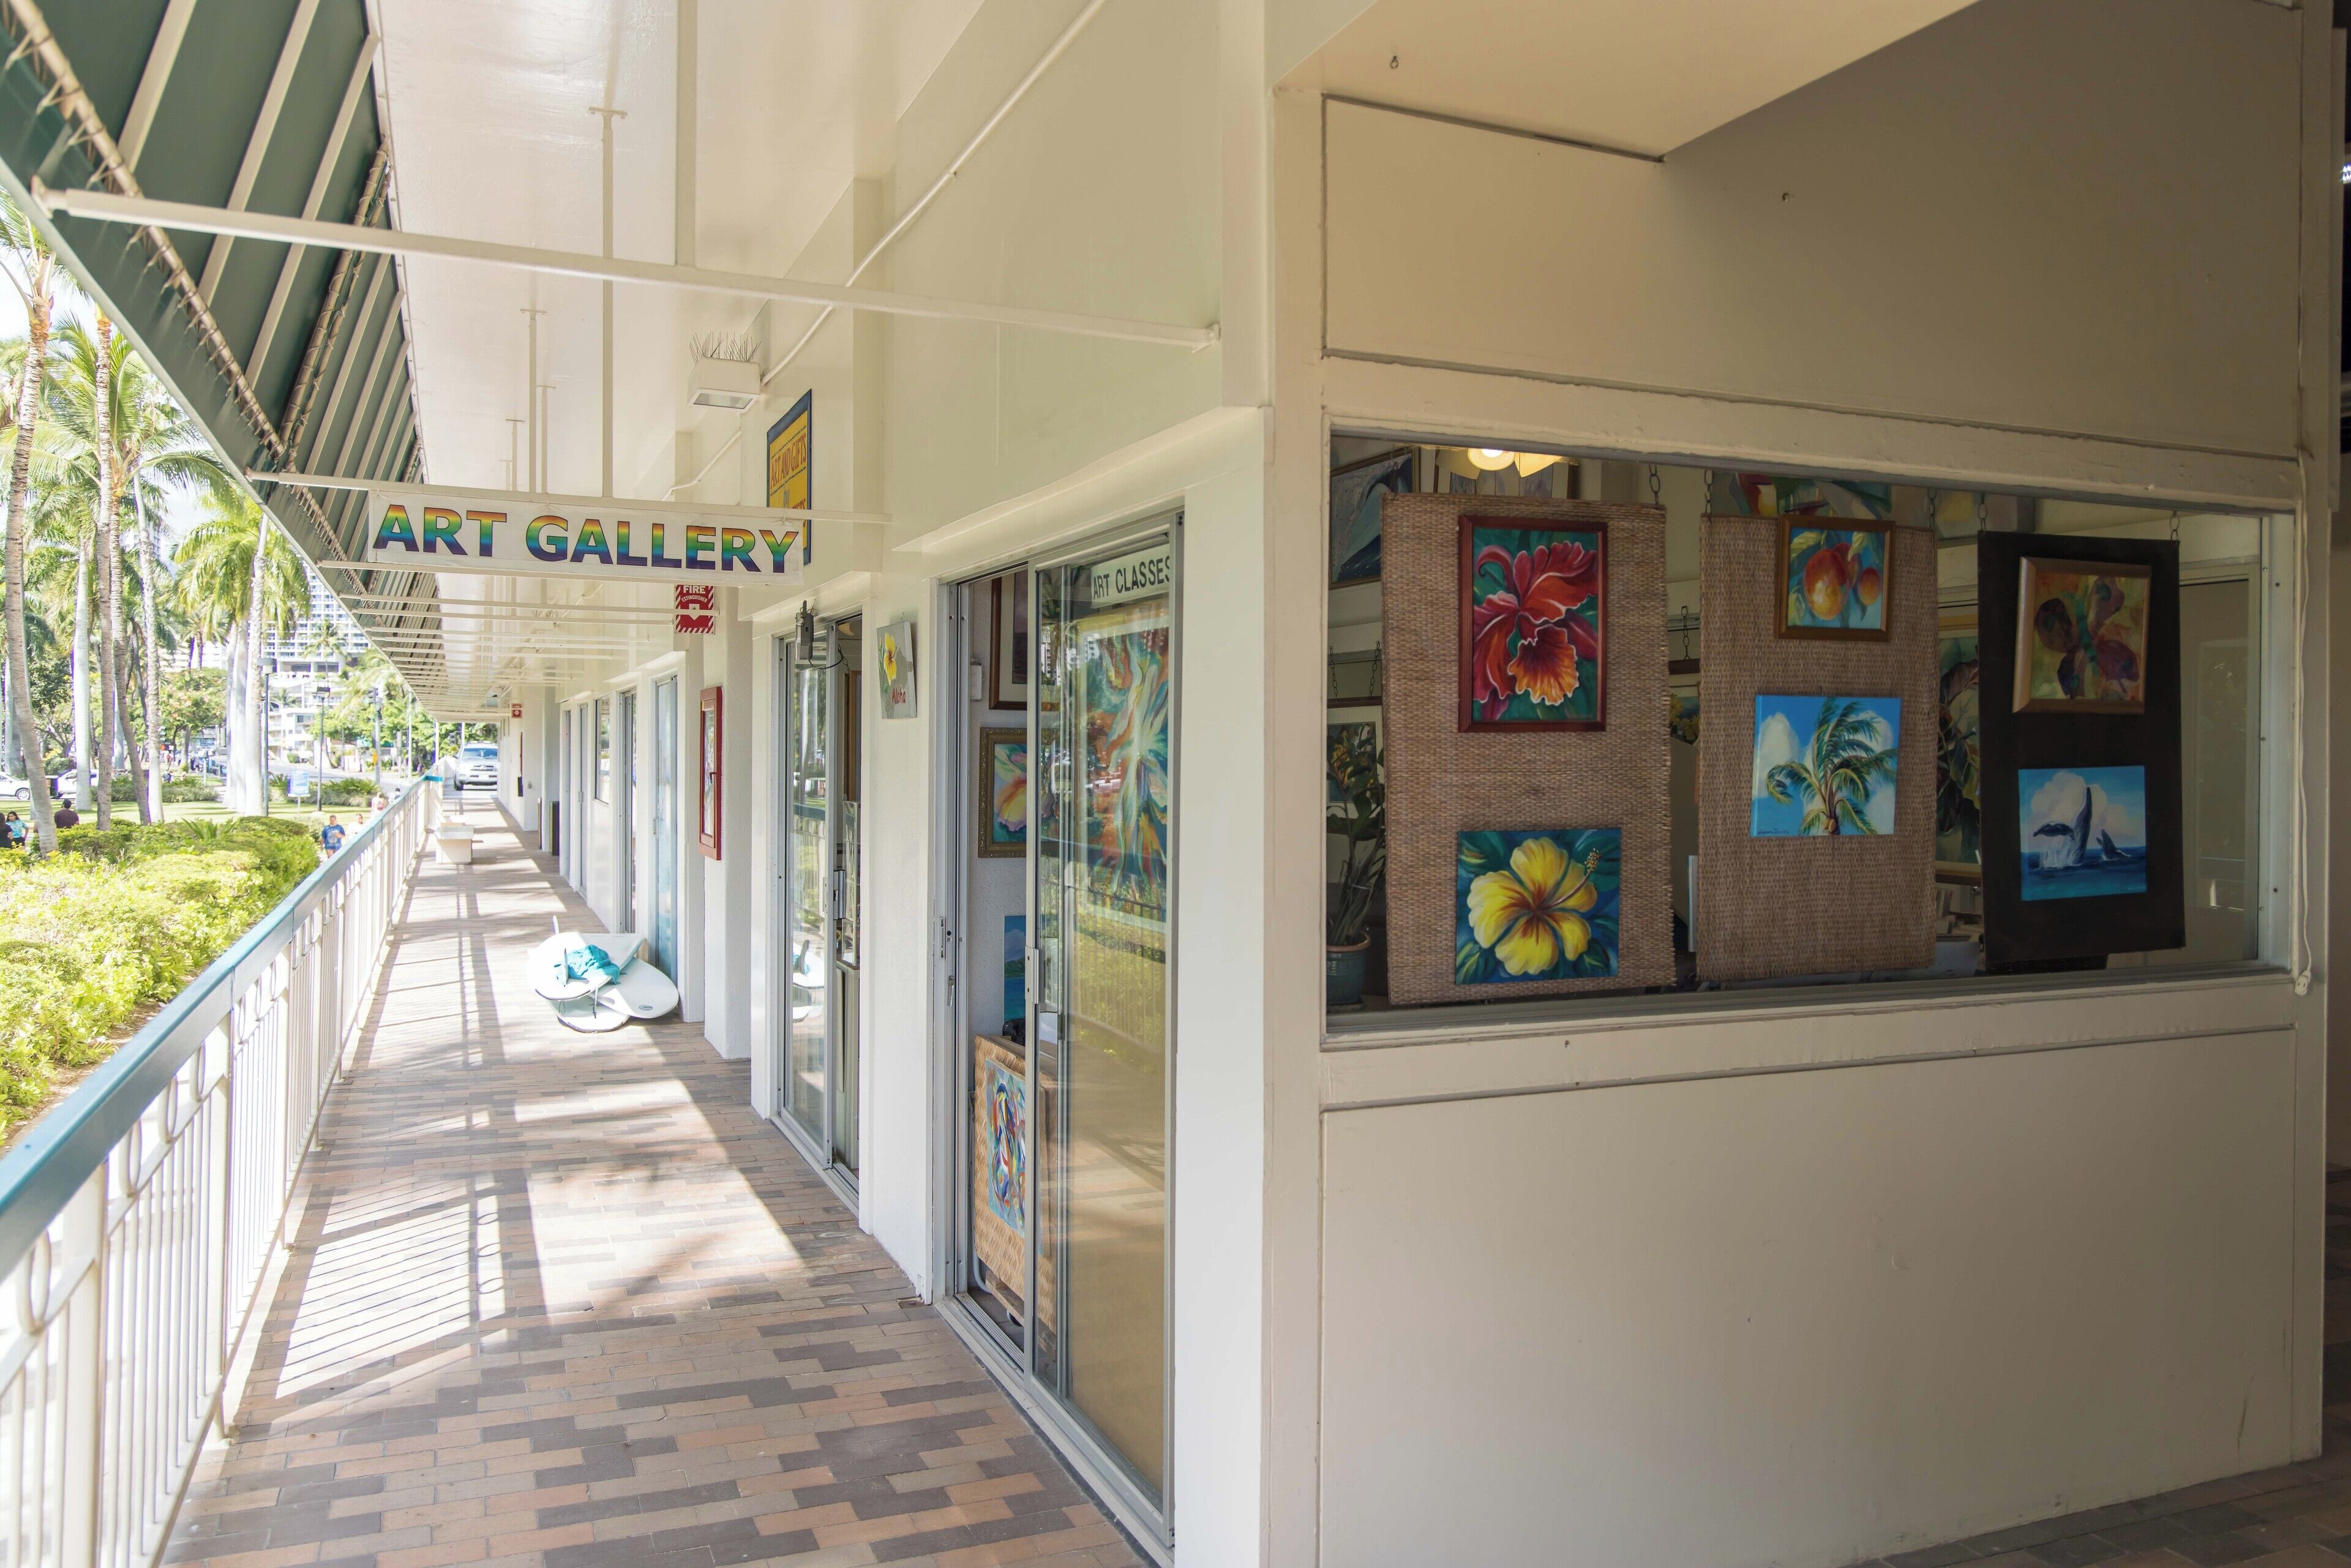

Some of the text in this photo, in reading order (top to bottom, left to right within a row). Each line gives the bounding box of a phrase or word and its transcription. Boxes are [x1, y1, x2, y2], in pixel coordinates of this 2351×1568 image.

[770, 433, 806, 490] ART AND GIFTS
[372, 504, 799, 574] ART GALLERY
[683, 585, 706, 594] FIRE
[1093, 555, 1170, 600] ART CLASSES
[681, 595, 708, 603] EXTINGUISHER
[891, 686, 906, 704] Aloha
